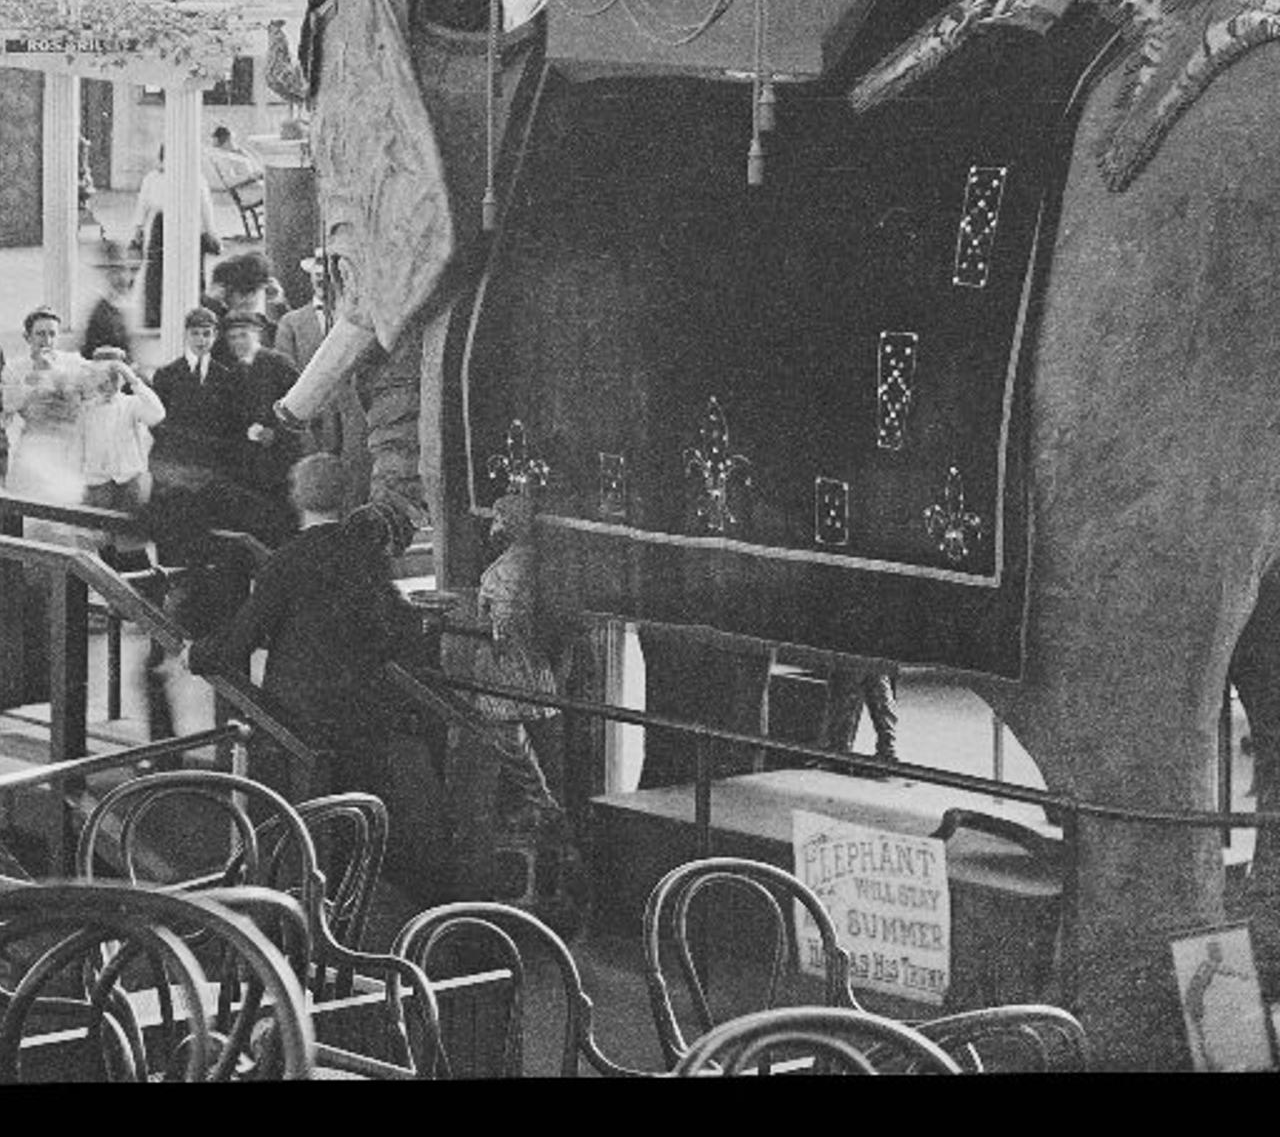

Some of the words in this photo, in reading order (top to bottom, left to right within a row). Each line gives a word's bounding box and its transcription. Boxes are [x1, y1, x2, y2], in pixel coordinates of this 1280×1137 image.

[804, 840, 937, 895] ELEPHANT
[854, 877, 895, 905] WILL
[847, 909, 946, 951] SUMMER
